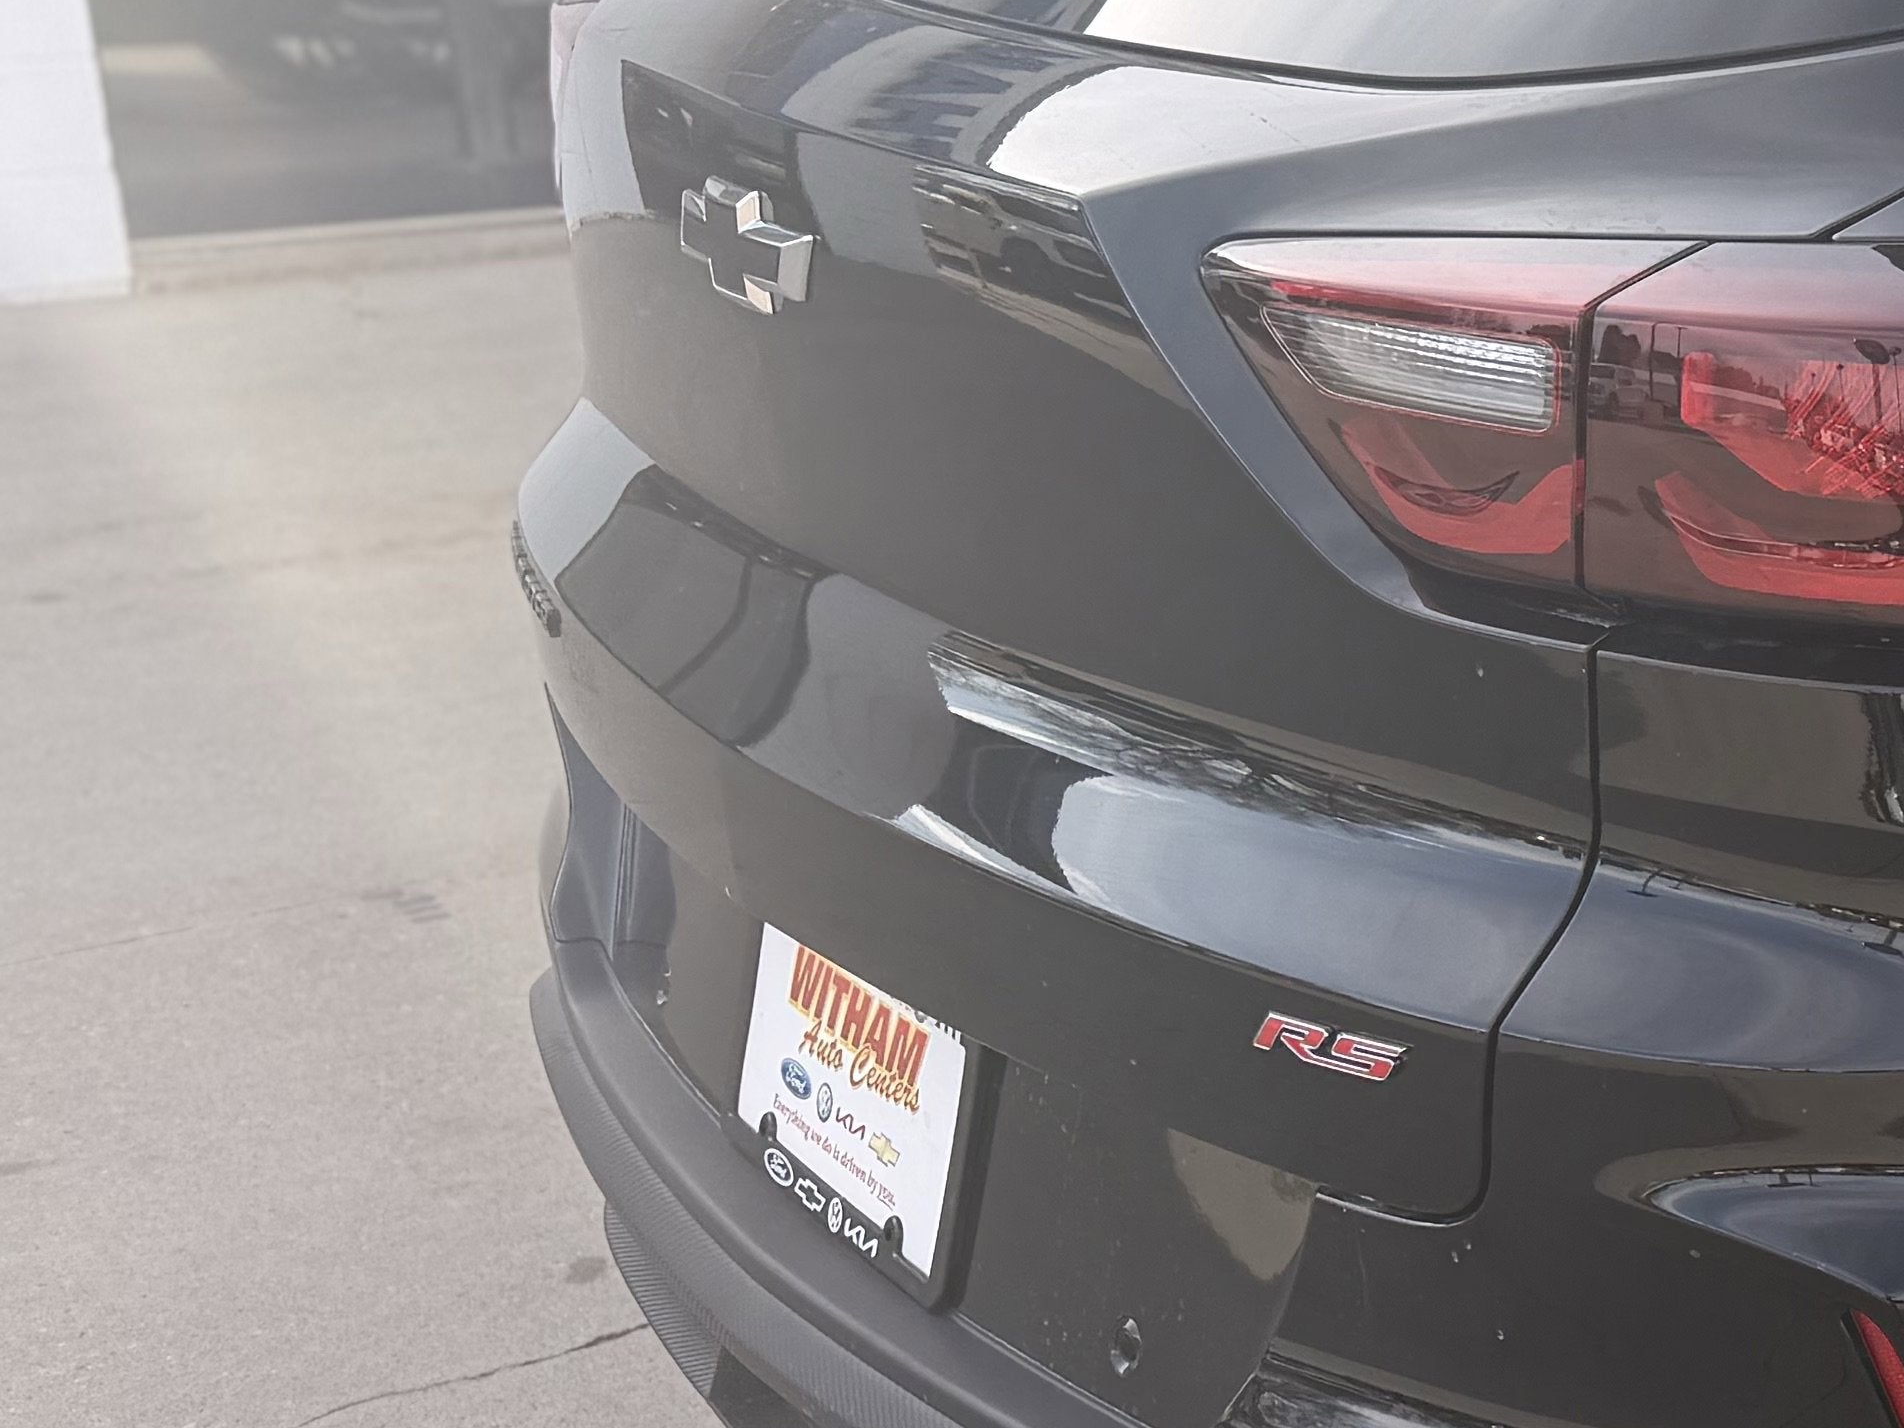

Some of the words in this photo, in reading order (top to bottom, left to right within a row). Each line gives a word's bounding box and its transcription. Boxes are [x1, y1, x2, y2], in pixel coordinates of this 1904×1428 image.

[788, 945, 930, 1087] WITHAM
[1253, 1012, 1408, 1081] RS
[799, 1020, 844, 1072] Auto
[849, 1044, 921, 1114] Centers
[841, 1152, 867, 1183] driven
[867, 1169, 879, 1195] by
